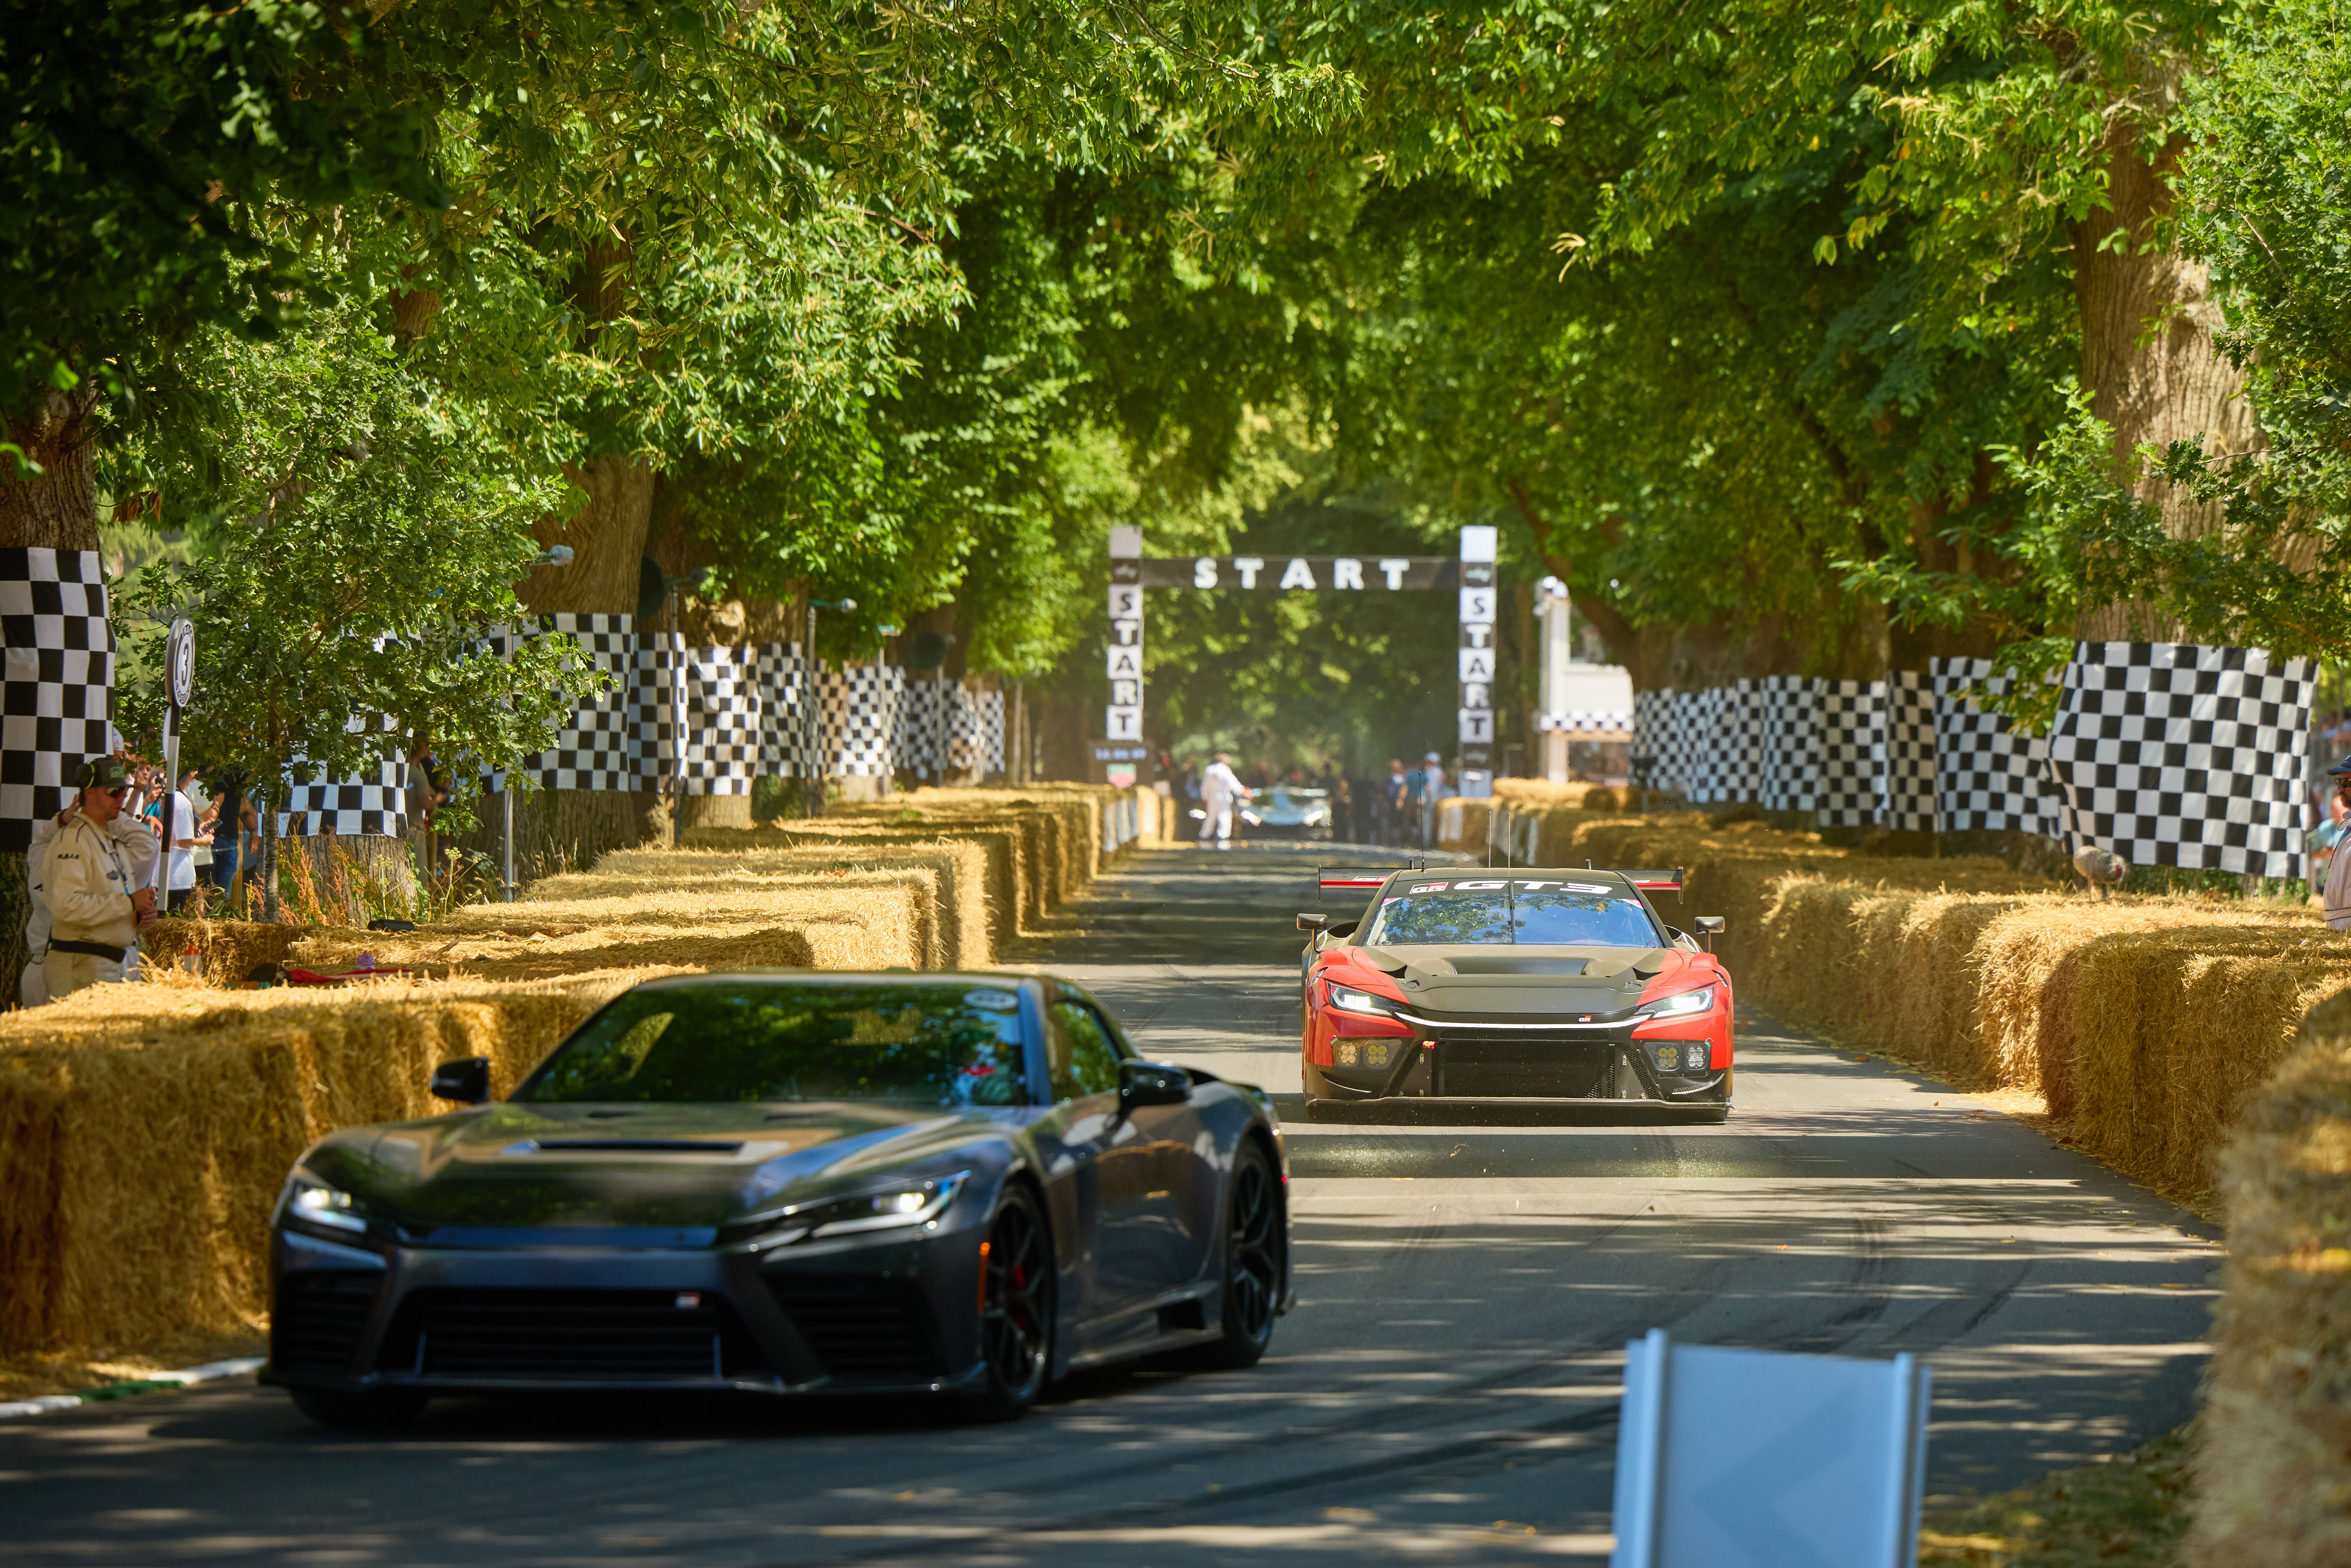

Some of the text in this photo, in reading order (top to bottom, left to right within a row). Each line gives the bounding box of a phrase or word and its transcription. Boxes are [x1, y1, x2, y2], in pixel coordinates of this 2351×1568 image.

[1194, 557, 1410, 590] START
[181, 643, 189, 686] 3
[1114, 593, 1137, 732] START
[1465, 597, 1491, 735] START
[1411, 881, 1612, 894] GR GT3
